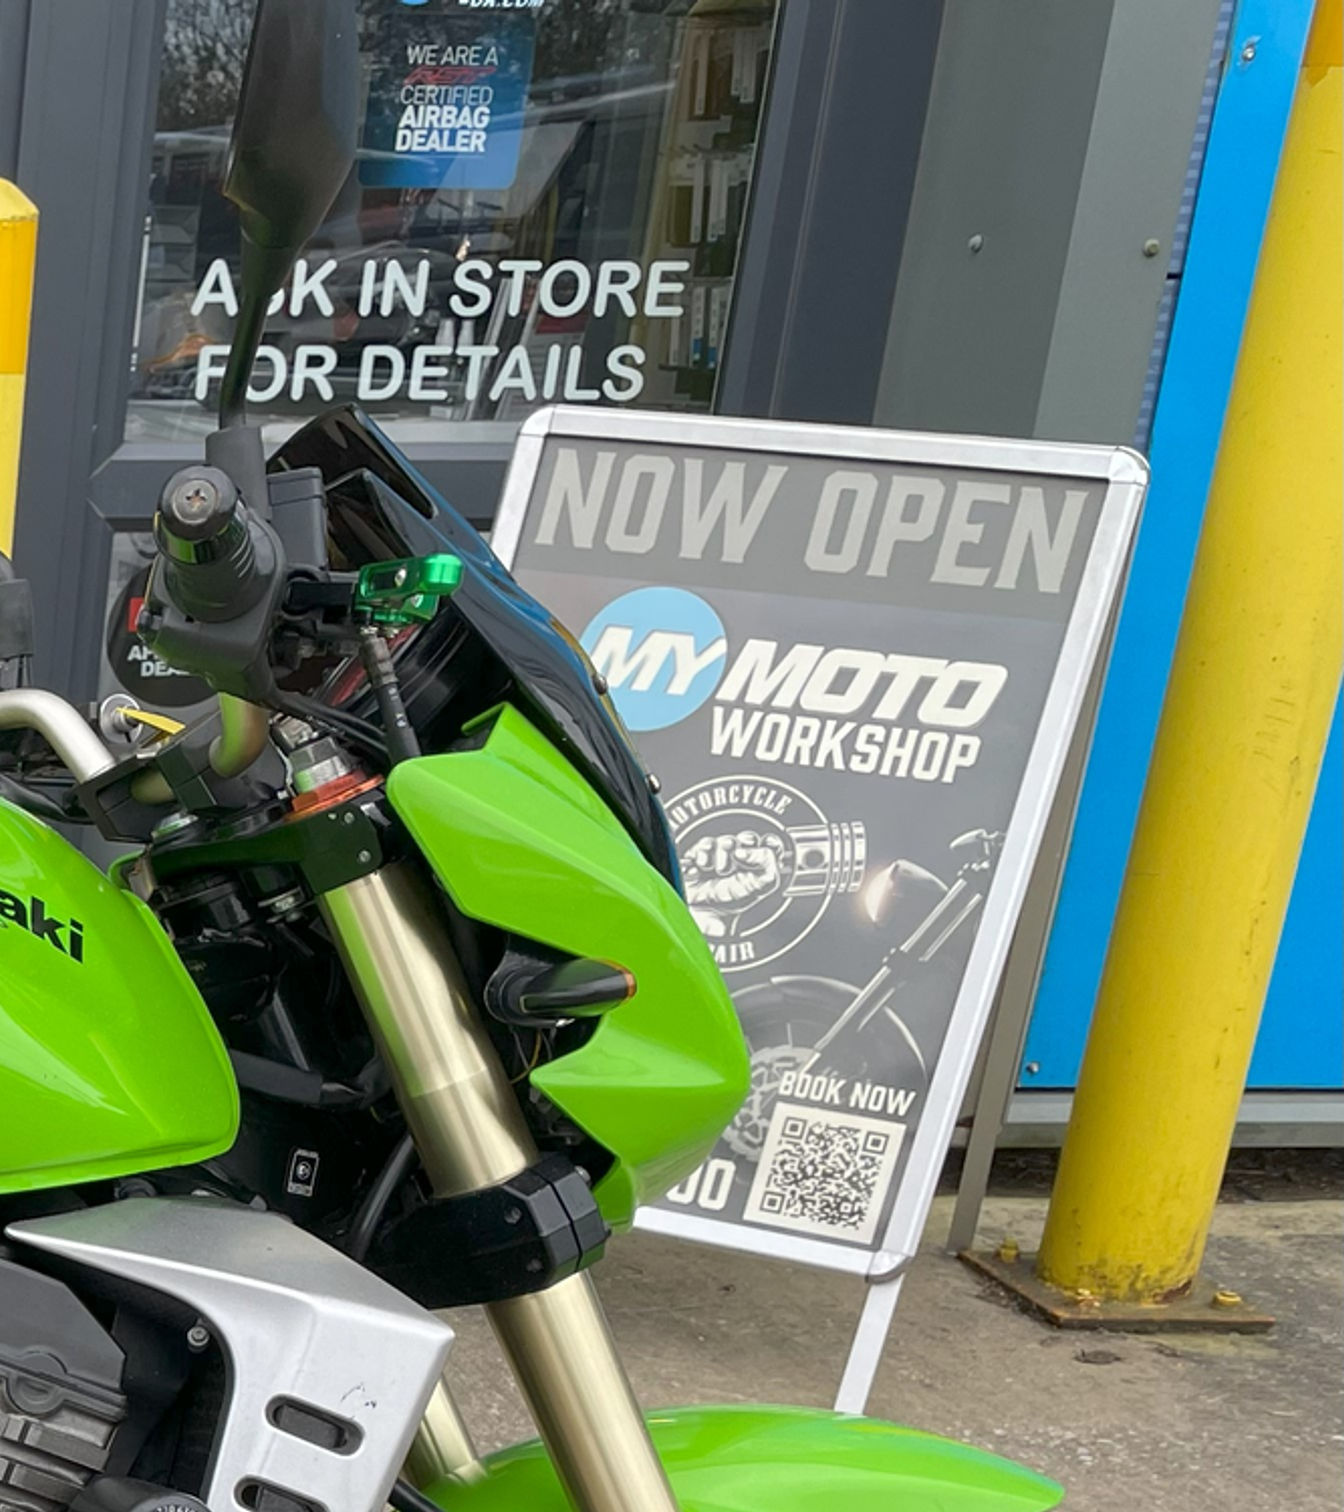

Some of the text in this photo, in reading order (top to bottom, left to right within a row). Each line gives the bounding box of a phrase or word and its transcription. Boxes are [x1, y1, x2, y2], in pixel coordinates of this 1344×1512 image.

[407, 44, 499, 66] WE ARE A
[398, 105, 491, 129] AIRBAG
[400, 85, 494, 106] CERTIFIED
[395, 128, 487, 152] DEALER
[358, 259, 430, 318] IN
[449, 259, 691, 318] STORE
[195, 343, 646, 403] FOR DETAILS
[534, 447, 1090, 595] NOW OPEN
[589, 625, 1009, 728] MY MOTO
[711, 705, 982, 785] WORKSHOP
[778, 1070, 917, 1117] BOOK NOW
